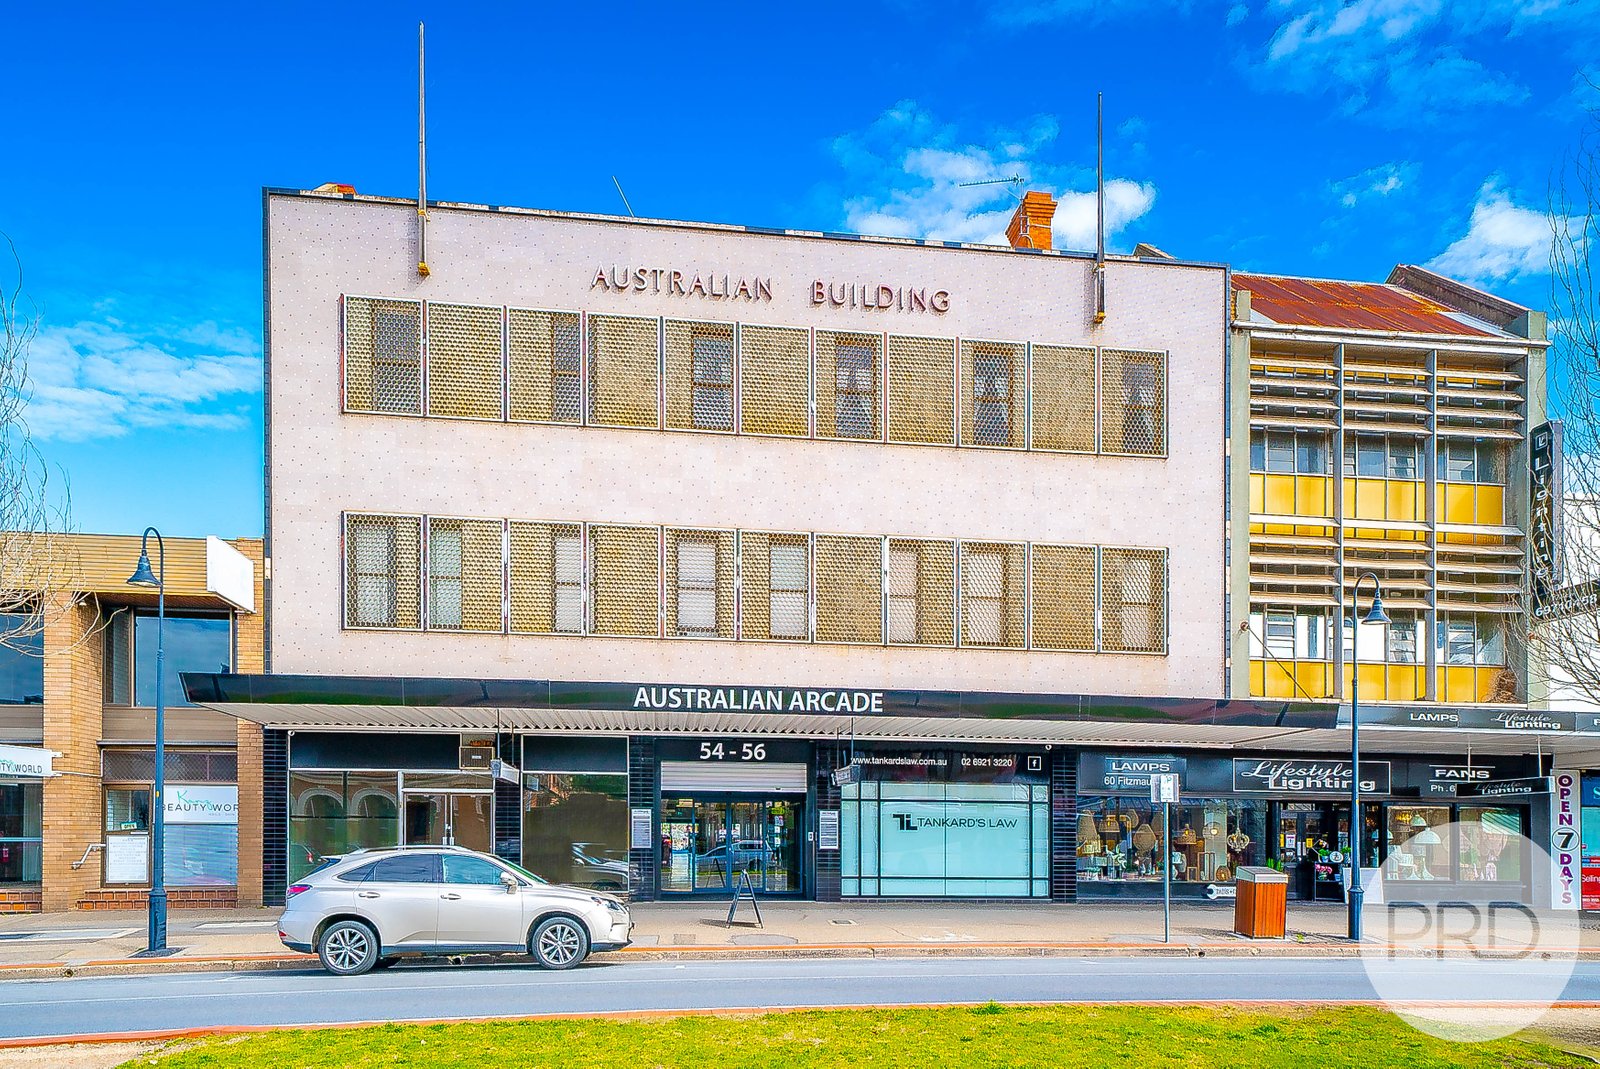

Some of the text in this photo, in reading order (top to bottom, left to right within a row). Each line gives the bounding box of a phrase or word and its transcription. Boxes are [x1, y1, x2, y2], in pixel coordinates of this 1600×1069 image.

[591, 263, 951, 312] AUSTRALIAN BUILDING
[633, 686, 884, 713] AUSTRALIAN ARCADE
[1410, 712, 1459, 722] LAMPS
[1491, 712, 1551, 722] Lifestyle
[1504, 720, 1561, 730] Lighting
[700, 742, 724, 760] 54
[741, 743, 766, 761] 56
[851, 757, 1013, 767] www.tankardslaw.com.au 02 6921 3220
[1112, 762, 1170, 772] LAMPS
[15, 764, 43, 773] WORLD
[1241, 761, 1353, 780] Lifestyle
[1435, 769, 1490, 779] FANS
[1104, 776, 1114, 785] 60
[1268, 776, 1376, 791] Lighting
[1481, 786, 1532, 795] Lighting
[1557, 774, 1573, 826] OPEN
[917, 818, 986, 828] TANKARD'S
[989, 818, 1018, 828] LAW
[1557, 832, 1574, 848] 7
[1560, 853, 1573, 904] DAYS
